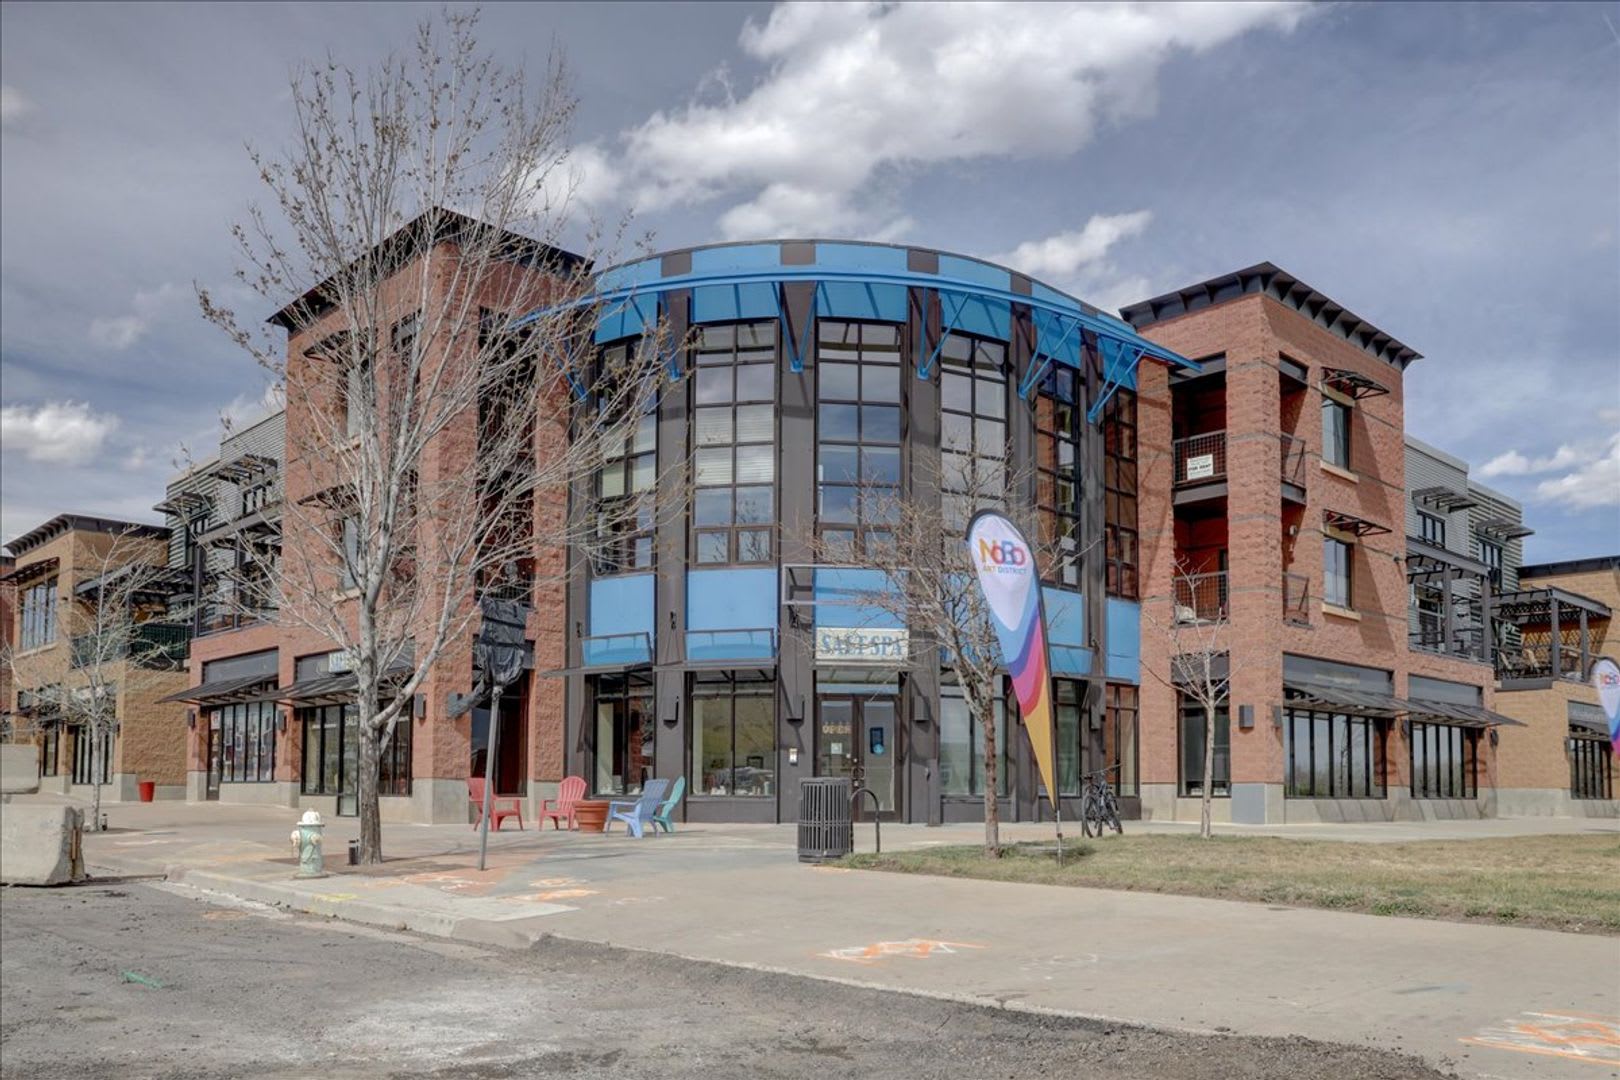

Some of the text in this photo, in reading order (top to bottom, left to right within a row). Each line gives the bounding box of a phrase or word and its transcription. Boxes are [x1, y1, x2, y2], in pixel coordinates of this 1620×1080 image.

[983, 565, 1027, 575] ART DISTRICT
[870, 634, 903, 656] SPA
